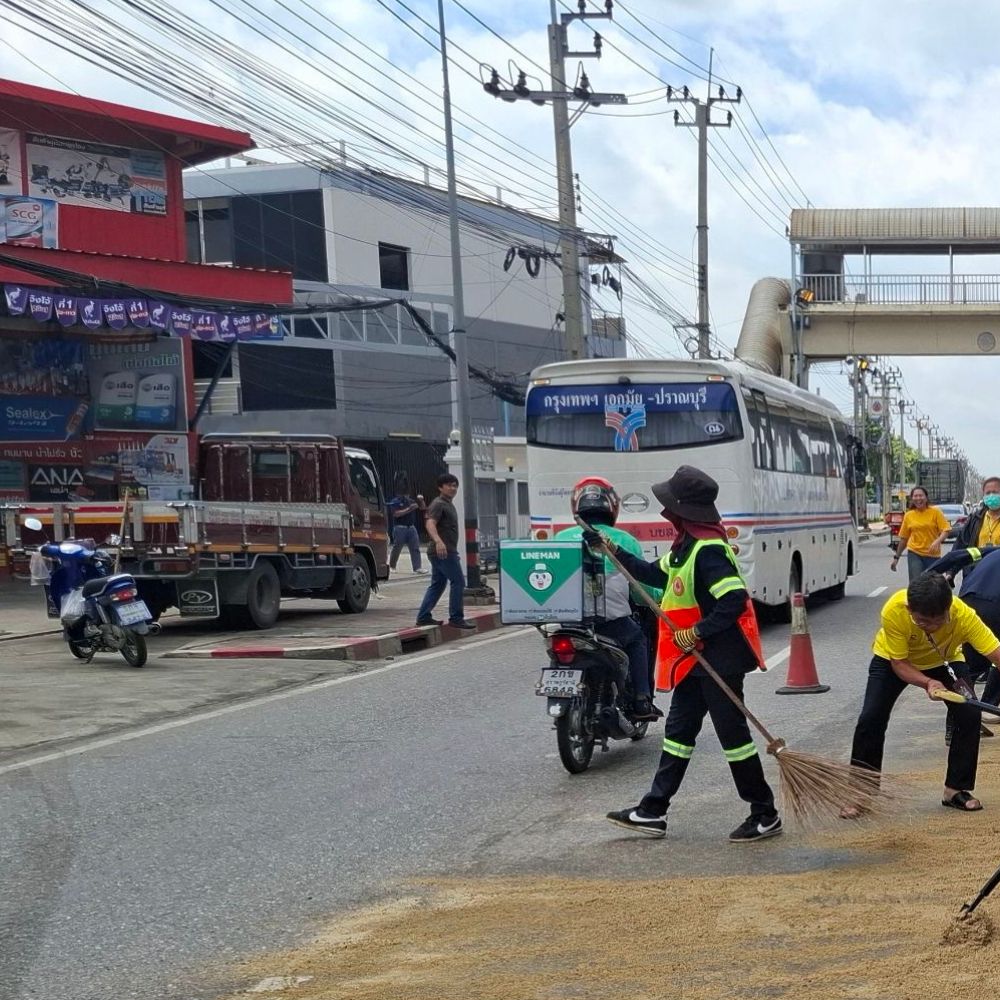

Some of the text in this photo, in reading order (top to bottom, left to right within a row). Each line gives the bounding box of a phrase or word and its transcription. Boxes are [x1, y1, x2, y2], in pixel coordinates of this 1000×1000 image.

[12, 209, 37, 220] SCG
[604, 389, 643, 405] เอกมัย
[6, 406, 47, 420] Sealex
[31, 467, 84, 485] ANA
